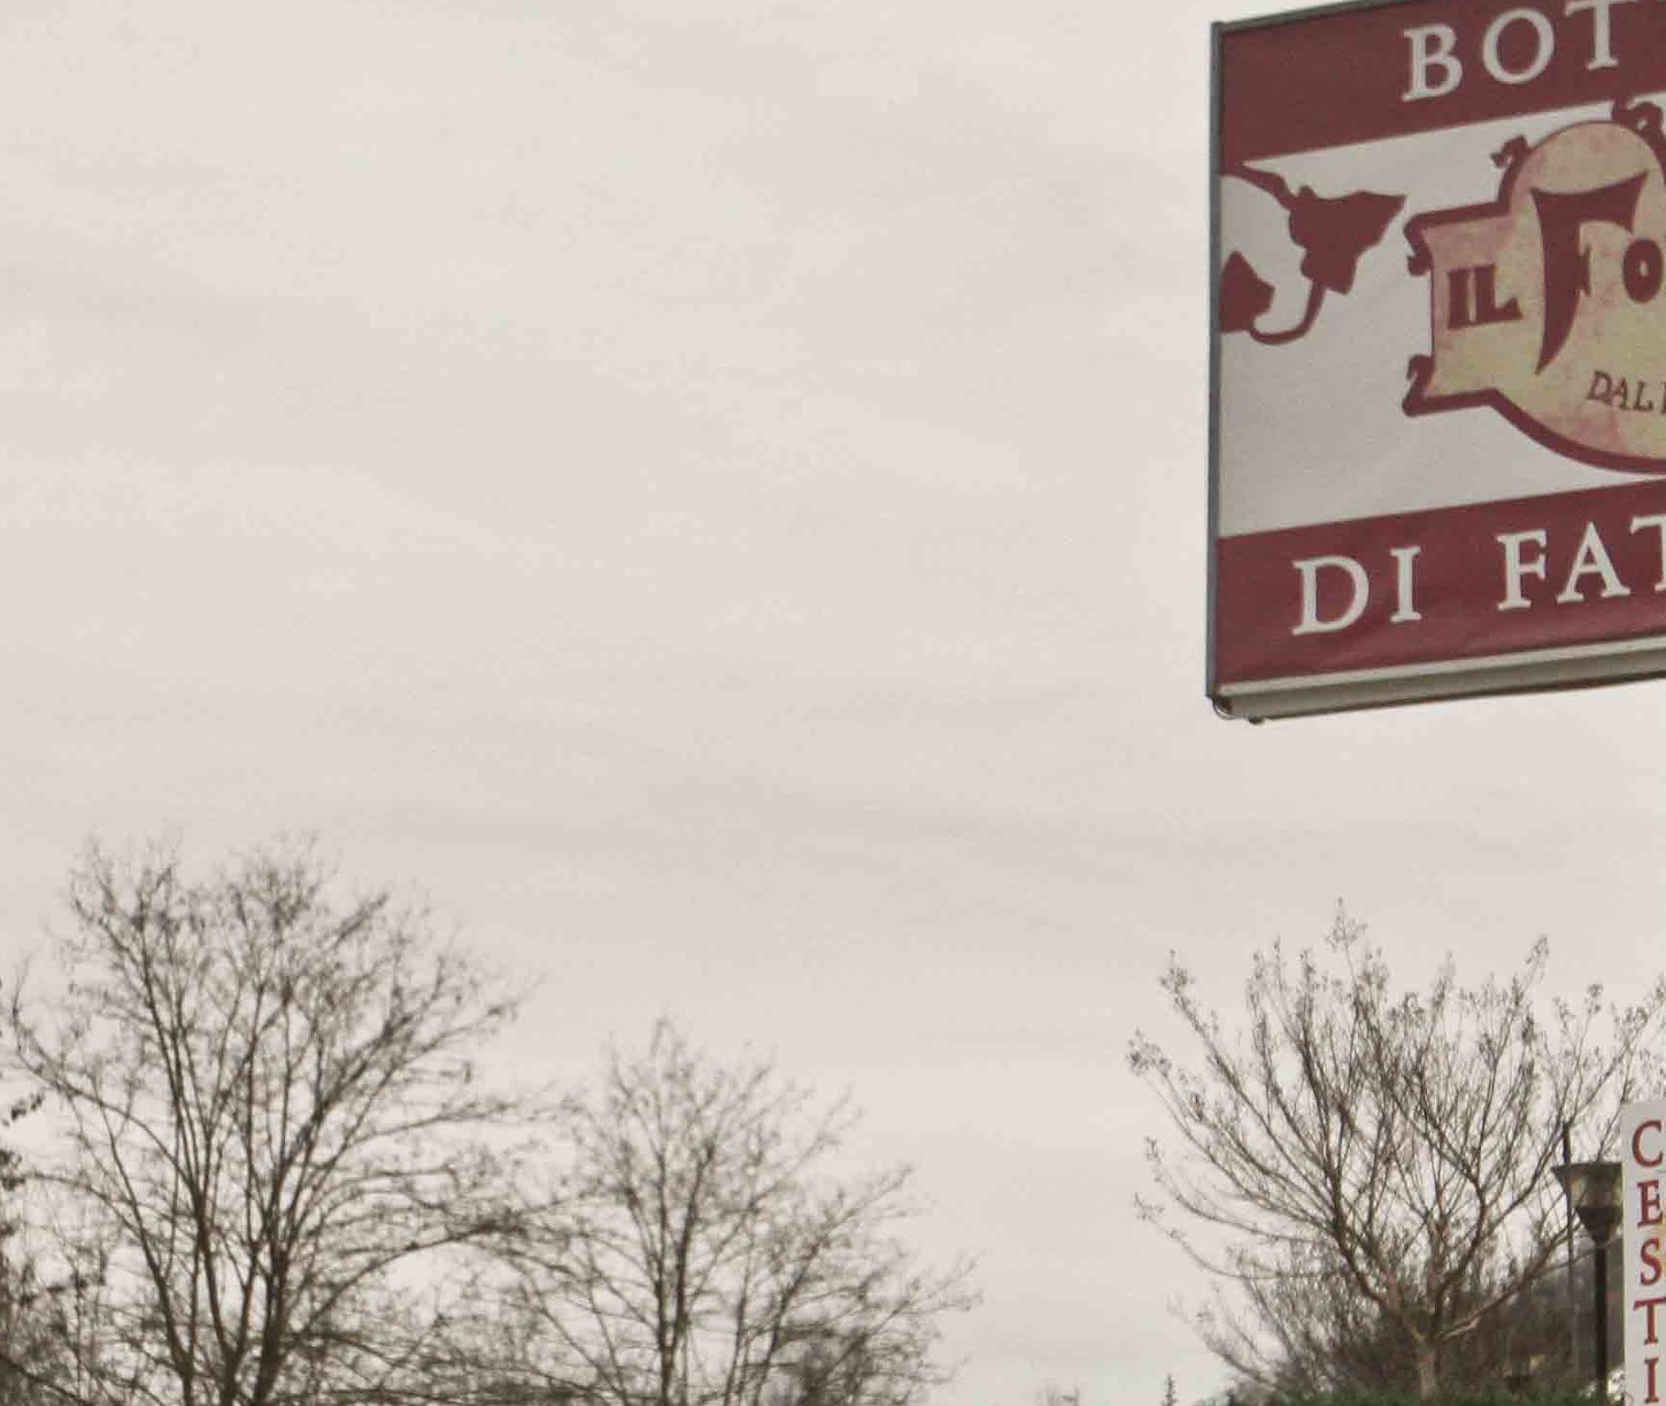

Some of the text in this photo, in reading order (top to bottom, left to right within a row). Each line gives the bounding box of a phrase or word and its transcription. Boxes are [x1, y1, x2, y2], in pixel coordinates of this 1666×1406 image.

[1446, 263, 1523, 331] IL
[1585, 370, 1654, 413] DAL
[1291, 545, 1422, 635] DI
